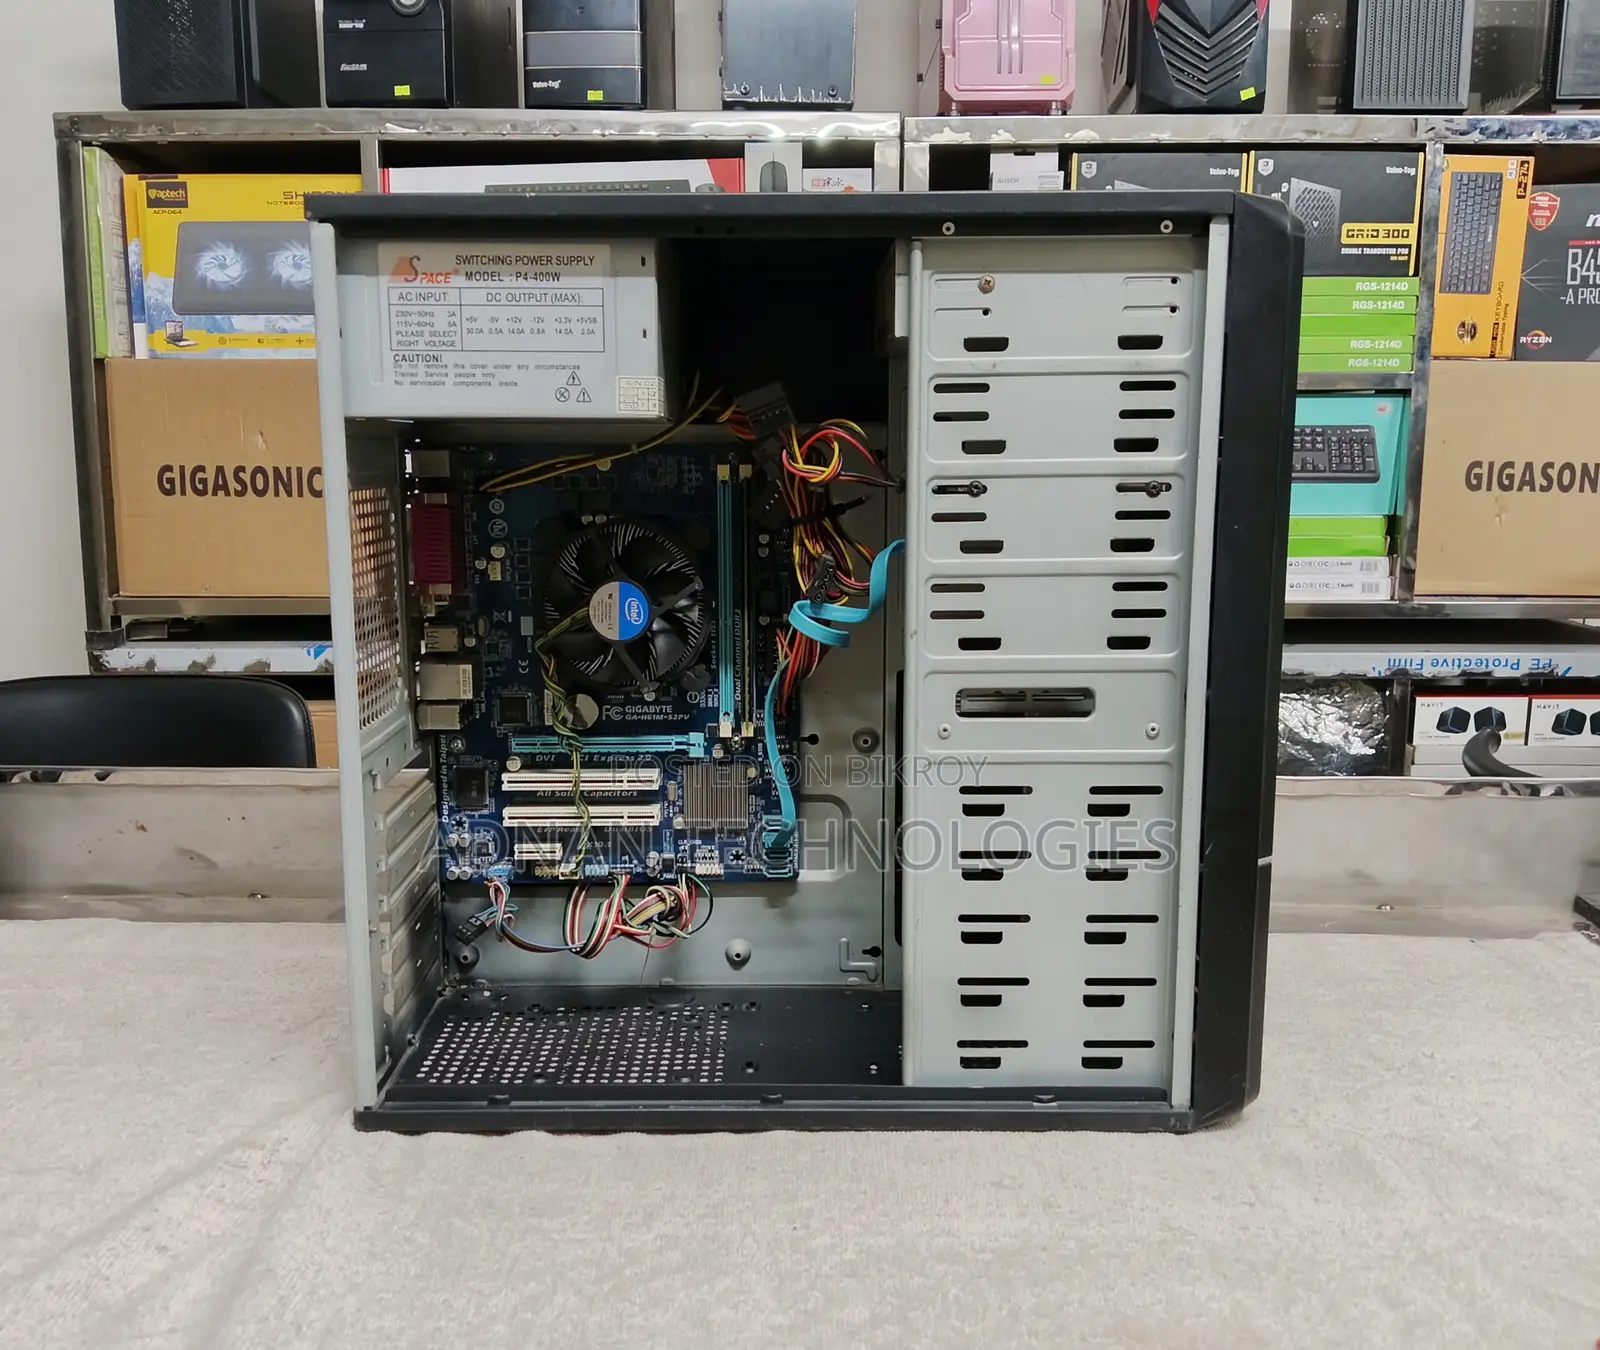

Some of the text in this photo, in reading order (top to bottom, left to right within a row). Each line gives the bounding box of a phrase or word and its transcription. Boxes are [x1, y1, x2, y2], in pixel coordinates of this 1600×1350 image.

[1517, 162, 1529, 196] P-274
[156, 188, 186, 199] aptech
[1382, 228, 1410, 238] 300
[456, 255, 594, 266] SWITCHING POWER SUPPLY
[464, 272, 504, 282] MODEL
[516, 272, 561, 282] P4-400W
[1356, 282, 1408, 290] RGS-1214D
[398, 292, 413, 302] AC
[486, 292, 502, 302] DC
[506, 292, 548, 303] OUTPUT
[1494, 281, 1504, 321] KEYBOARD
[1352, 300, 1405, 310] RGS-1214D
[396, 330, 457, 338] PLEASE SELECT
[396, 340, 456, 348] RIGHT VOLTAGE
[1350, 340, 1402, 348] RGS-1214D
[1520, 336, 1552, 344] RYZEN
[393, 354, 442, 363] CAUTION!
[1348, 358, 1400, 367] RGS-1214D
[157, 464, 324, 498] GIGASONIC
[1465, 460, 1600, 494] GIGASON
[1431, 658, 1520, 671] Protective
[625, 705, 672, 713] GIGABYTE
[593, 754, 634, 762] Express
[439, 734, 450, 823] Designed in Taipei
[584, 790, 638, 798] Capacitors
